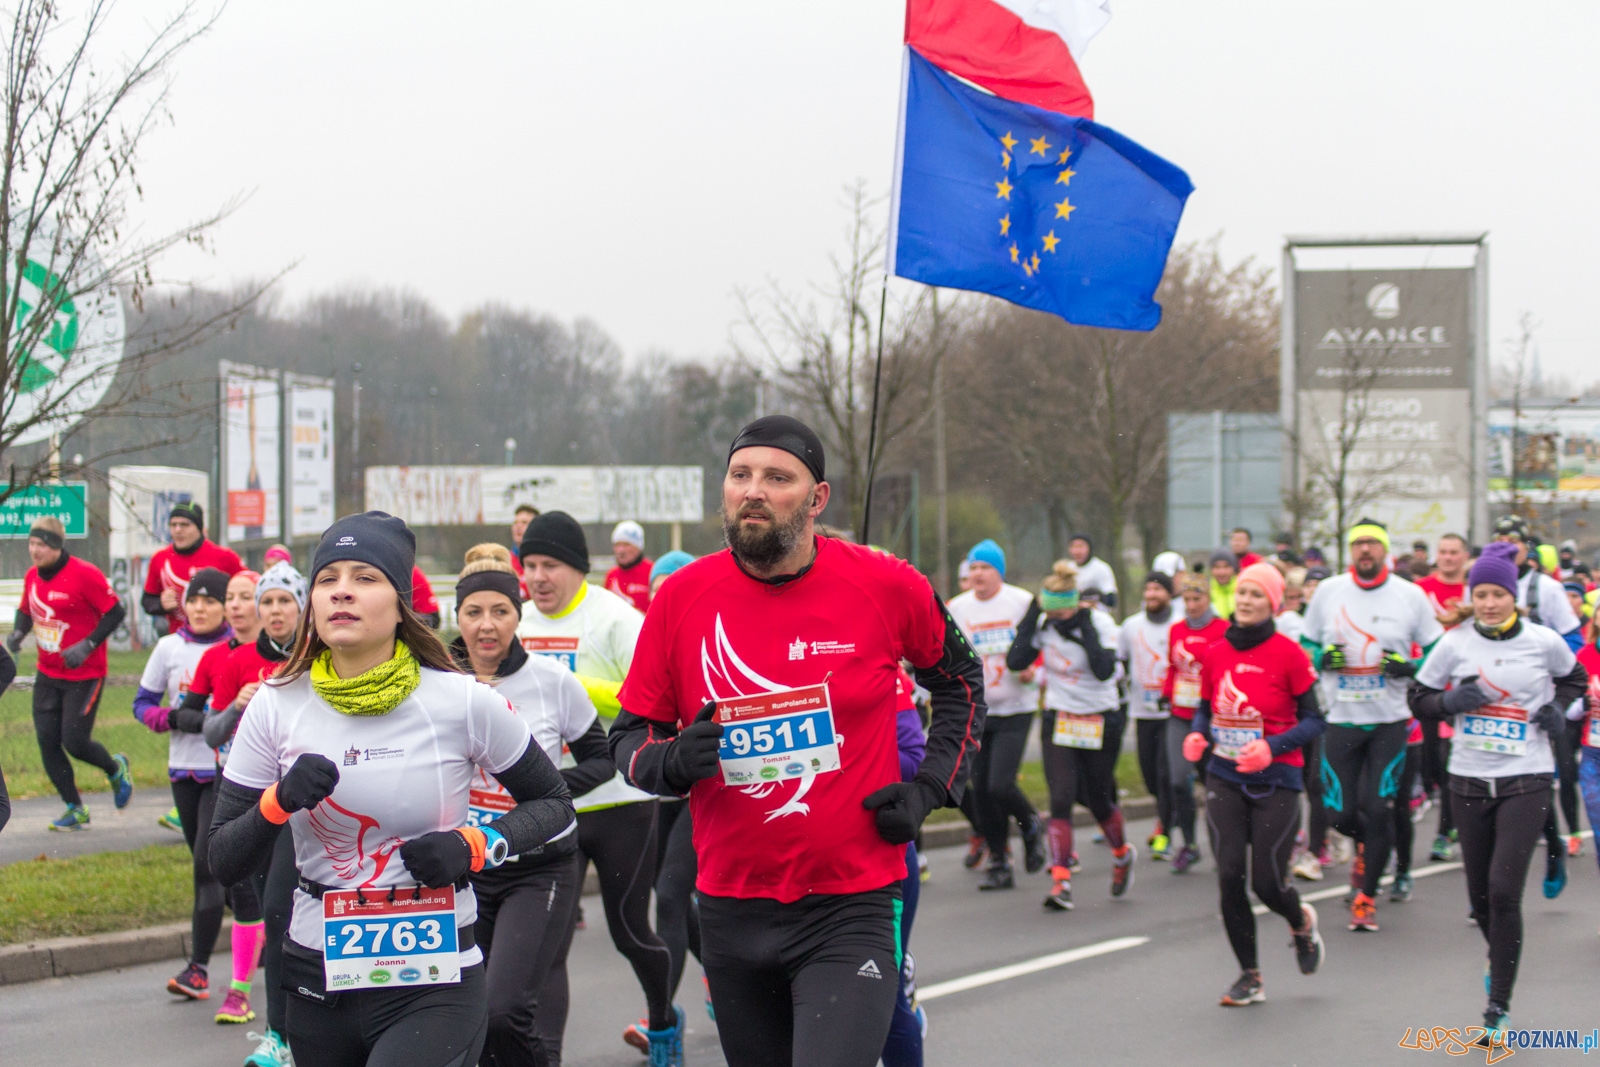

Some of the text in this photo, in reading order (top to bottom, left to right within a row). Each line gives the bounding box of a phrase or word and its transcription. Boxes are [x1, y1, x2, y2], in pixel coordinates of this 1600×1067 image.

[1320, 326, 1446, 344] AVANCE
[771, 697, 820, 710] RunPoland.org
[1470, 719, 1521, 739] 8943
[729, 717, 818, 755] 9511
[762, 755, 791, 764] Tomasz
[392, 897, 447, 907] RunPoland.org
[327, 919, 443, 955] E 2763
[374, 959, 407, 967] Joanna
[333, 973, 351, 981] GRUPA
[333, 979, 355, 987] LUXMED
